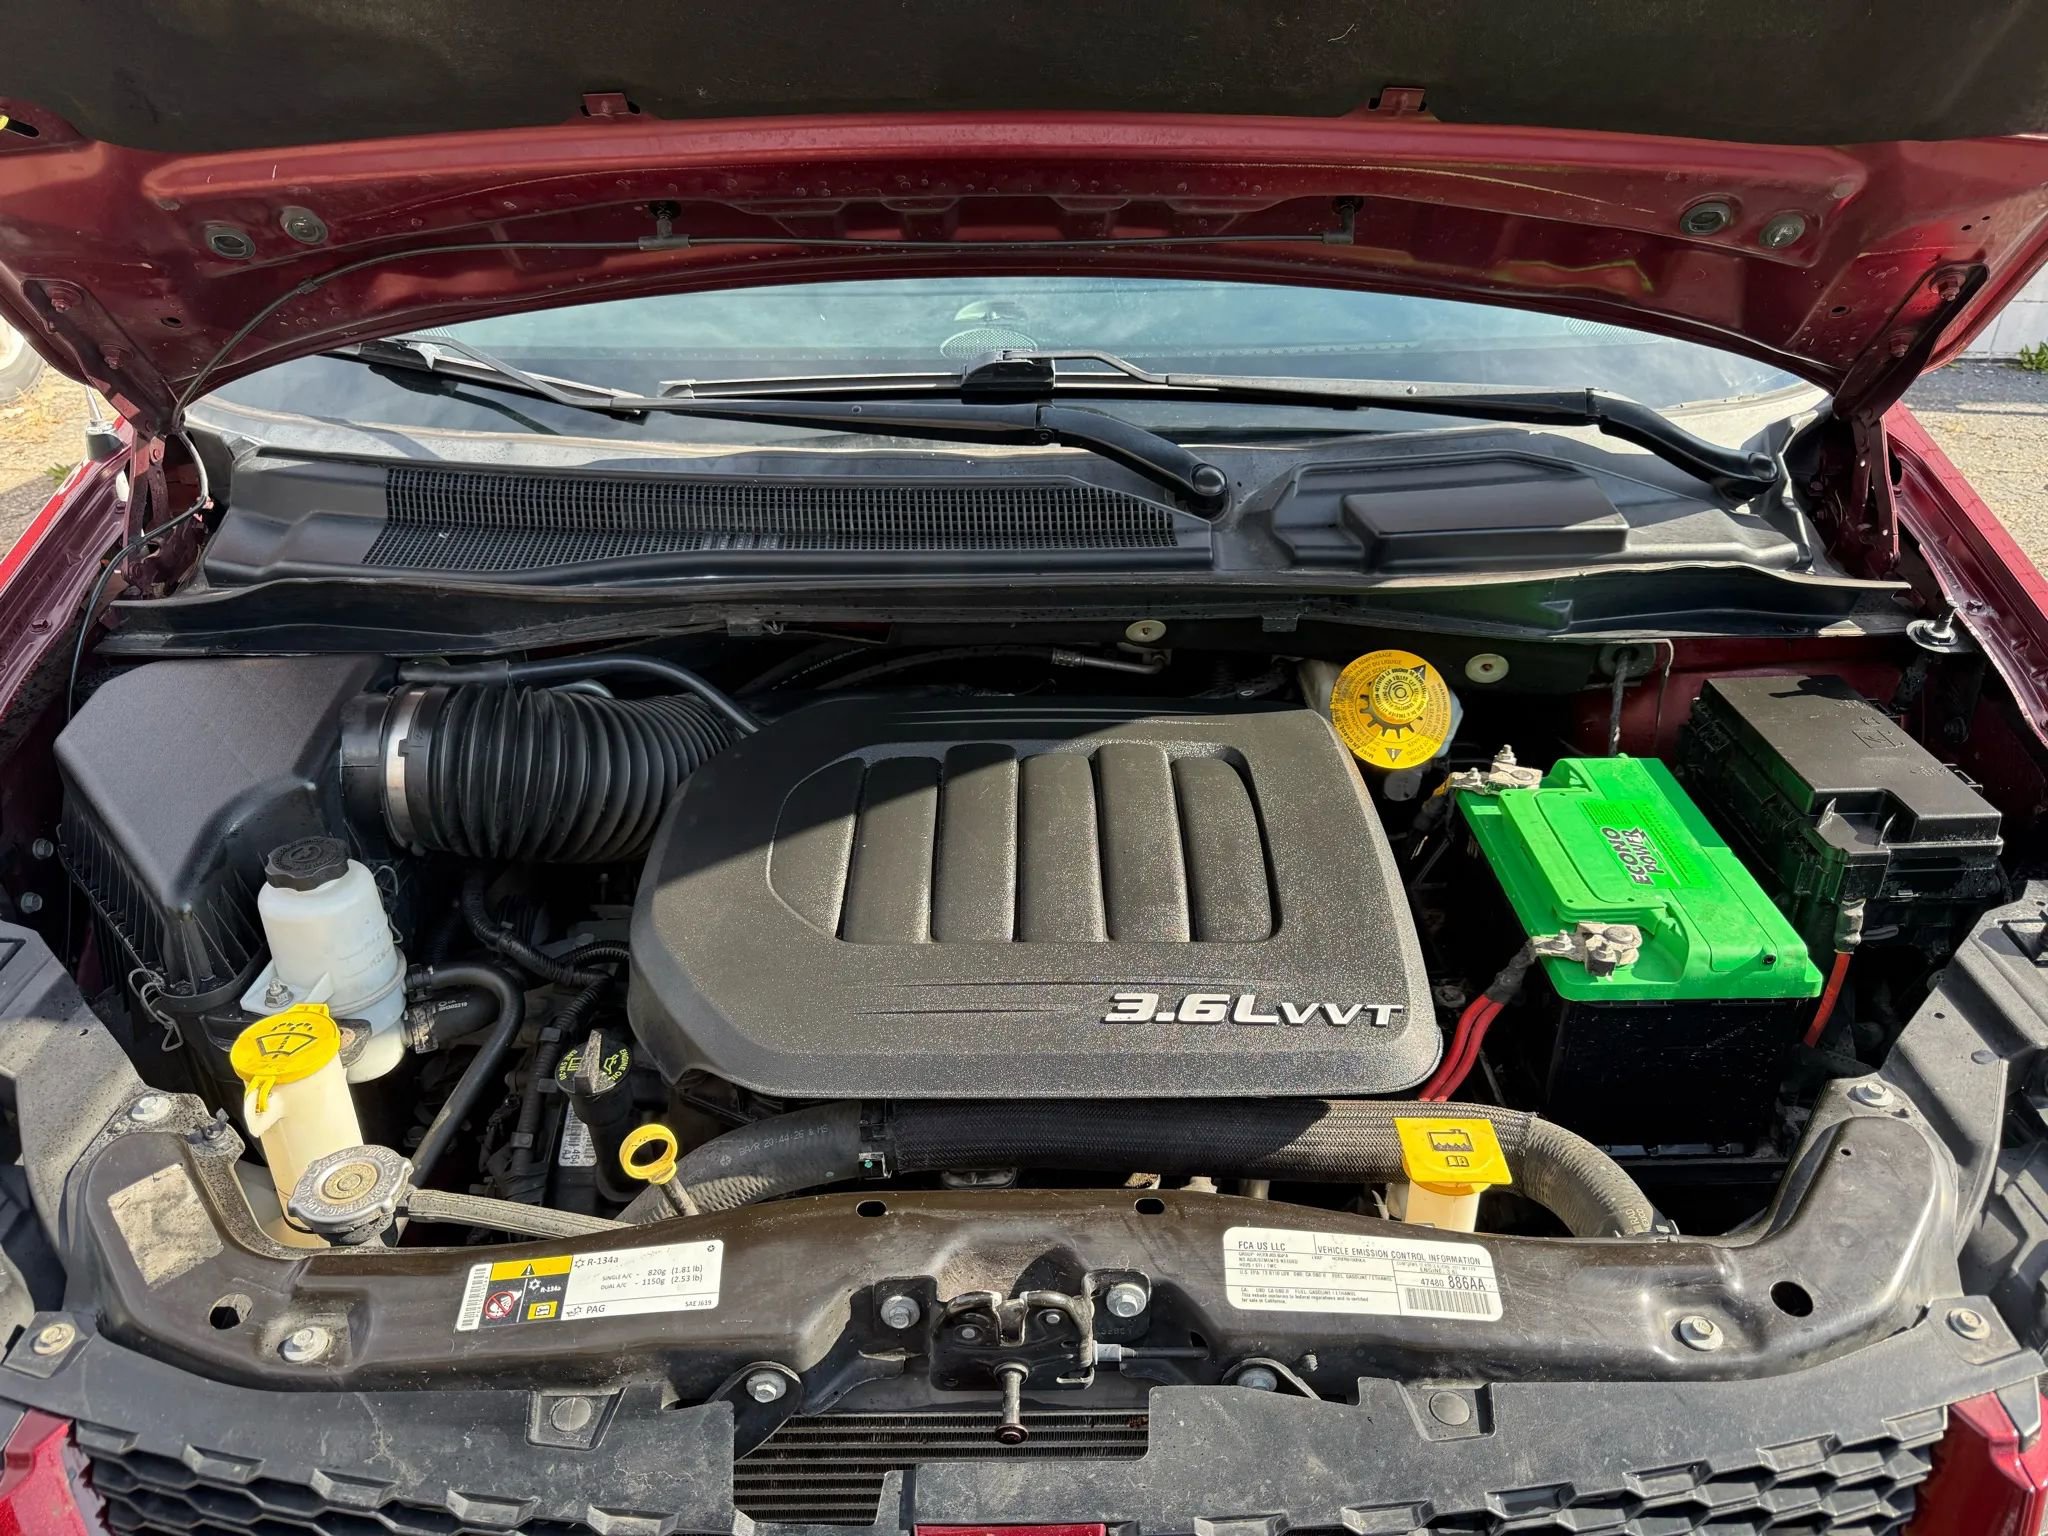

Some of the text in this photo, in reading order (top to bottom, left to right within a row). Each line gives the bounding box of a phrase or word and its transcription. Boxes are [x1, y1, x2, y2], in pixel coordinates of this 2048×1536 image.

[1602, 827, 1654, 886] ECONO
[1621, 827, 1664, 874] POWER
[608, 1048, 630, 1081] ENGINE OIL
[1238, 1241, 1286, 1251] FCA US LLC
[586, 1256, 619, 1266] R-134a
[1317, 1246, 1480, 1264] VEHICLE EMISSION CONTROL INFORMATION
[648, 1268, 666, 1277] 820g
[671, 1266, 689, 1276] (1.81
[692, 1265, 703, 1273] lb)
[642, 1277, 666, 1287] 1150g
[671, 1275, 689, 1284] (2.53
[692, 1274, 703, 1283] lb)
[1447, 1275, 1486, 1291] 886AA
[586, 1304, 606, 1313] PAG
